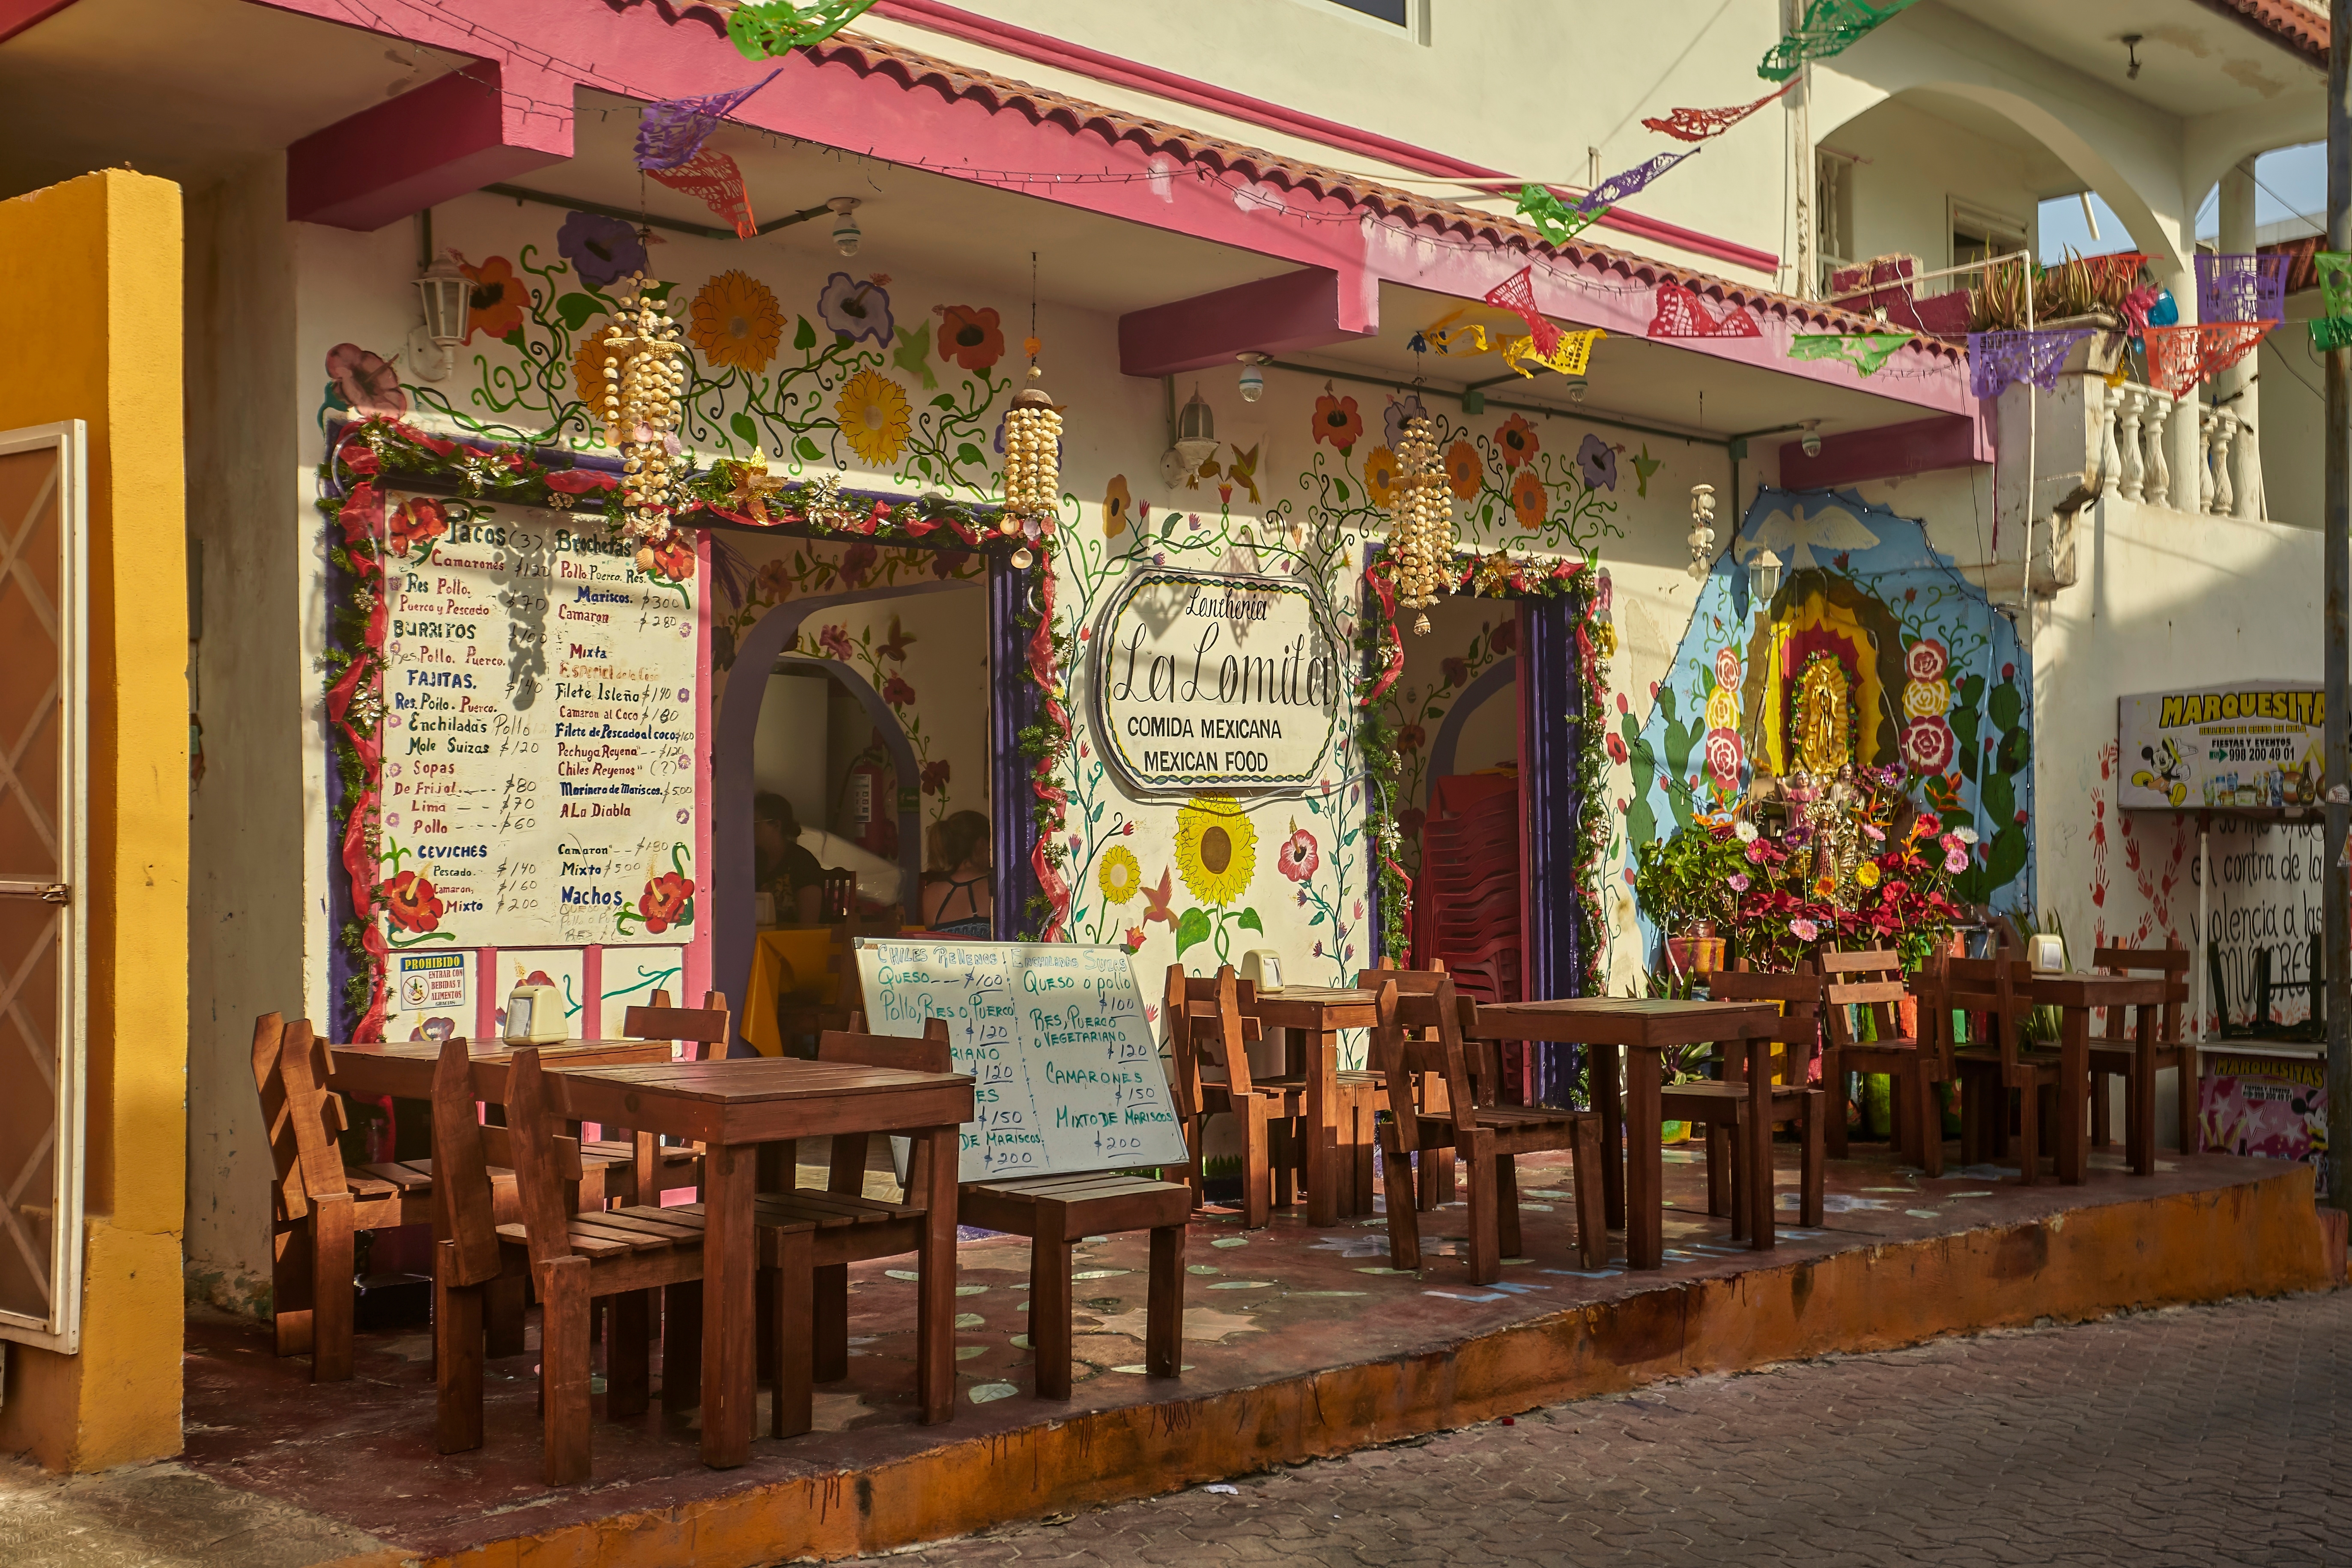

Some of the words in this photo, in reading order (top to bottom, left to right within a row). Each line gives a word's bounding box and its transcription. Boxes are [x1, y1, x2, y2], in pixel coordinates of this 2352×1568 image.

[444, 516, 506, 546] Tacos
[510, 530, 543, 551] (3)
[555, 529, 632, 557] Brochetas
[431, 549, 504, 571] Camarones
[561, 561, 587, 579] Pollo
[405, 573, 428, 593] Res
[437, 605, 443, 615] y
[446, 599, 490, 615] Pescado
[558, 603, 609, 623] Camaron
[394, 620, 476, 639] BURRITOS
[570, 643, 607, 659] Mixta
[1181, 622, 1331, 706] Lomita
[555, 683, 592, 700] Filete
[597, 683, 639, 702] Isleño
[559, 705, 599, 718] Camaron
[604, 709, 612, 720] al
[615, 710, 638, 721] Coco
[409, 711, 487, 733] Enchiladas
[493, 714, 530, 736] Pollo
[555, 723, 586, 738] Filete
[589, 727, 600, 737] de
[1128, 716, 1194, 738] COMIDA
[1201, 719, 1282, 739] MEXICANA
[406, 737, 436, 756] Mole
[447, 737, 490, 754] Suizas
[558, 742, 600, 762] Pechuga
[2212, 739, 2244, 748] FIESTAS
[2246, 739, 2251, 747] Y
[2255, 738, 2291, 747] EVENTOS
[1144, 751, 1218, 772] MEXICAN
[1226, 751, 1268, 772] FOOD
[2249, 748, 2266, 761] 200
[2283, 746, 2294, 761] 01
[414, 760, 454, 778] Sopas
[558, 762, 589, 776] Chiles
[393, 782, 409, 796] De
[609, 784, 619, 794] de
[412, 800, 446, 812] Lima
[591, 803, 631, 818] Diabla
[412, 819, 447, 834] Pollo
[418, 845, 487, 859] CEVICHES
[559, 862, 601, 877] Mixto
[2224, 838, 2276, 887] contra
[2281, 839, 2301, 884] de
[2309, 839, 2322, 884] la
[561, 886, 622, 906] Nachos
[444, 900, 483, 914] Mixto
[2284, 904, 2298, 940] a
[405, 956, 460, 970] PROHIBIDO
[878, 944, 928, 965] CHILES
[1011, 948, 1079, 968] ENCHILADAS
[429, 970, 451, 979] ENTRAR
[878, 966, 929, 990] QUESO
[1024, 970, 1074, 995] QUESO
[431, 980, 455, 989] BEBIDAS
[431, 991, 461, 1001] ALIMENTOS
[1044, 1031, 1125, 1048] VEGETARIANO
[1047, 1061, 1143, 1084] CAMARONES
[2215, 1057, 2324, 1089] MARQUESITAS
[1125, 1108, 1173, 1126] MARISCOS
[959, 1133, 980, 1151] DE
